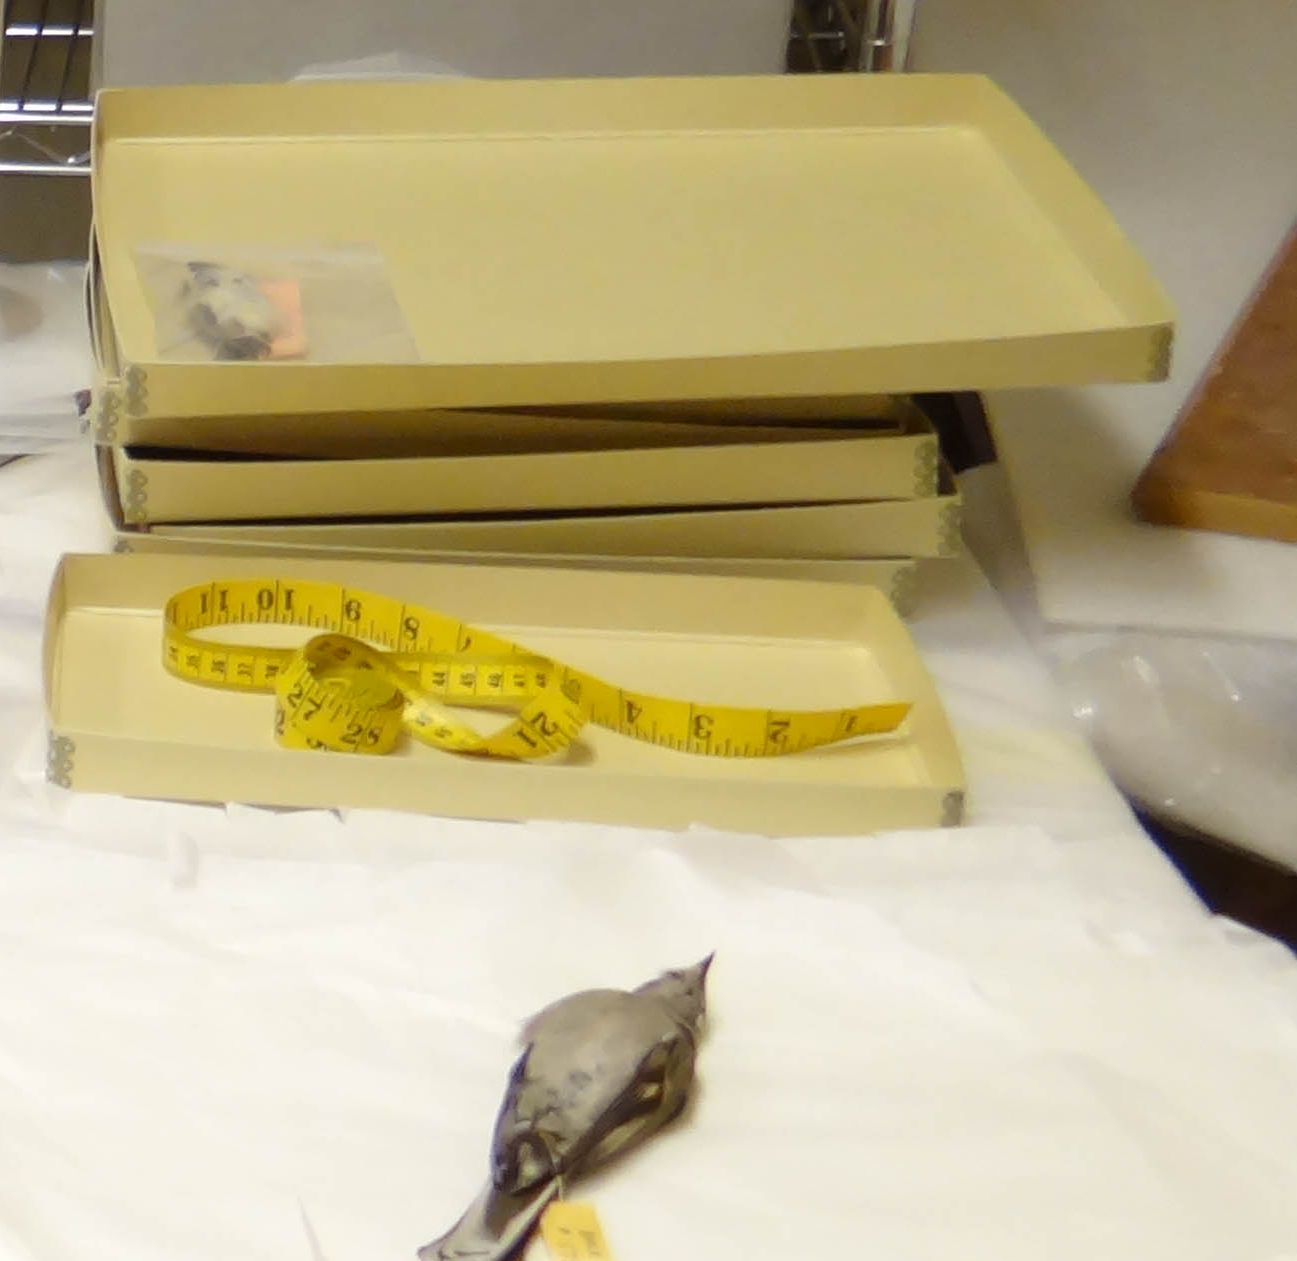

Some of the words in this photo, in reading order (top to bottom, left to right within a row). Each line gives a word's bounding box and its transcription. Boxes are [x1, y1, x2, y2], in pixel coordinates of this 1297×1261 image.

[257, 588, 295, 612] 10
[344, 599, 362, 622] 9
[404, 616, 420, 640] 8
[624, 699, 643, 725] 4
[693, 714, 715, 740] 3
[769, 720, 791, 745] 2
